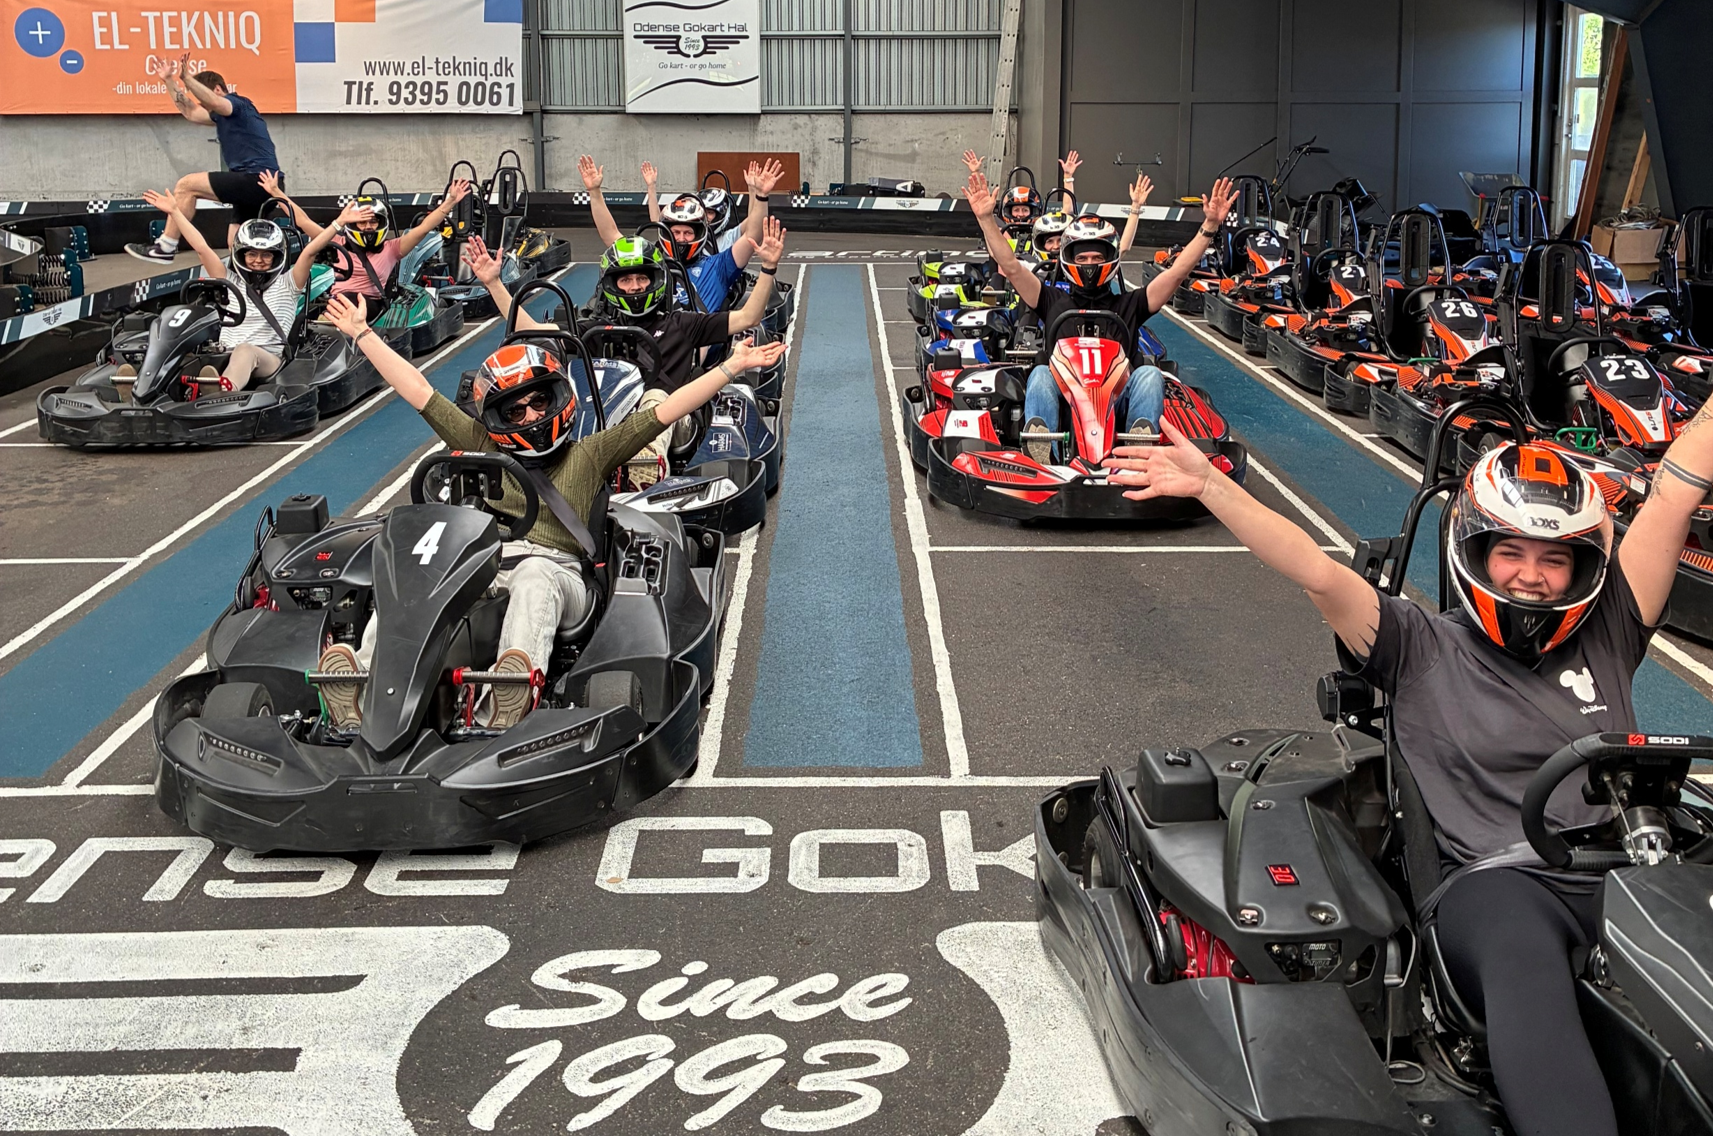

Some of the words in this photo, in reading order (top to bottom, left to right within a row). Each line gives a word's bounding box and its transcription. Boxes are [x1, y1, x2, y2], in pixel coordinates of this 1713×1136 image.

[92, 11, 261, 56] EL-TEKNIQ
[633, 22, 680, 32] Odense
[683, 22, 725, 32] Gokart
[728, 22, 748, 32] Hal
[364, 55, 515, 81] www.el-tekniq.dk
[708, 61, 727, 69] home
[112, 82, 132, 94] -din
[344, 81, 379, 105] Tlf.
[387, 81, 449, 106] 9395
[457, 81, 515, 107] 0061
[168, 308, 192, 327] 9
[1441, 301, 1478, 318] 26
[1079, 348, 1103, 375] 11
[1600, 358, 1651, 382] 23
[411, 521, 448, 565] 4
[1647, 736, 1690, 745] SODI
[485, 948, 913, 1029] Since
[467, 1033, 911, 1133] 1993
